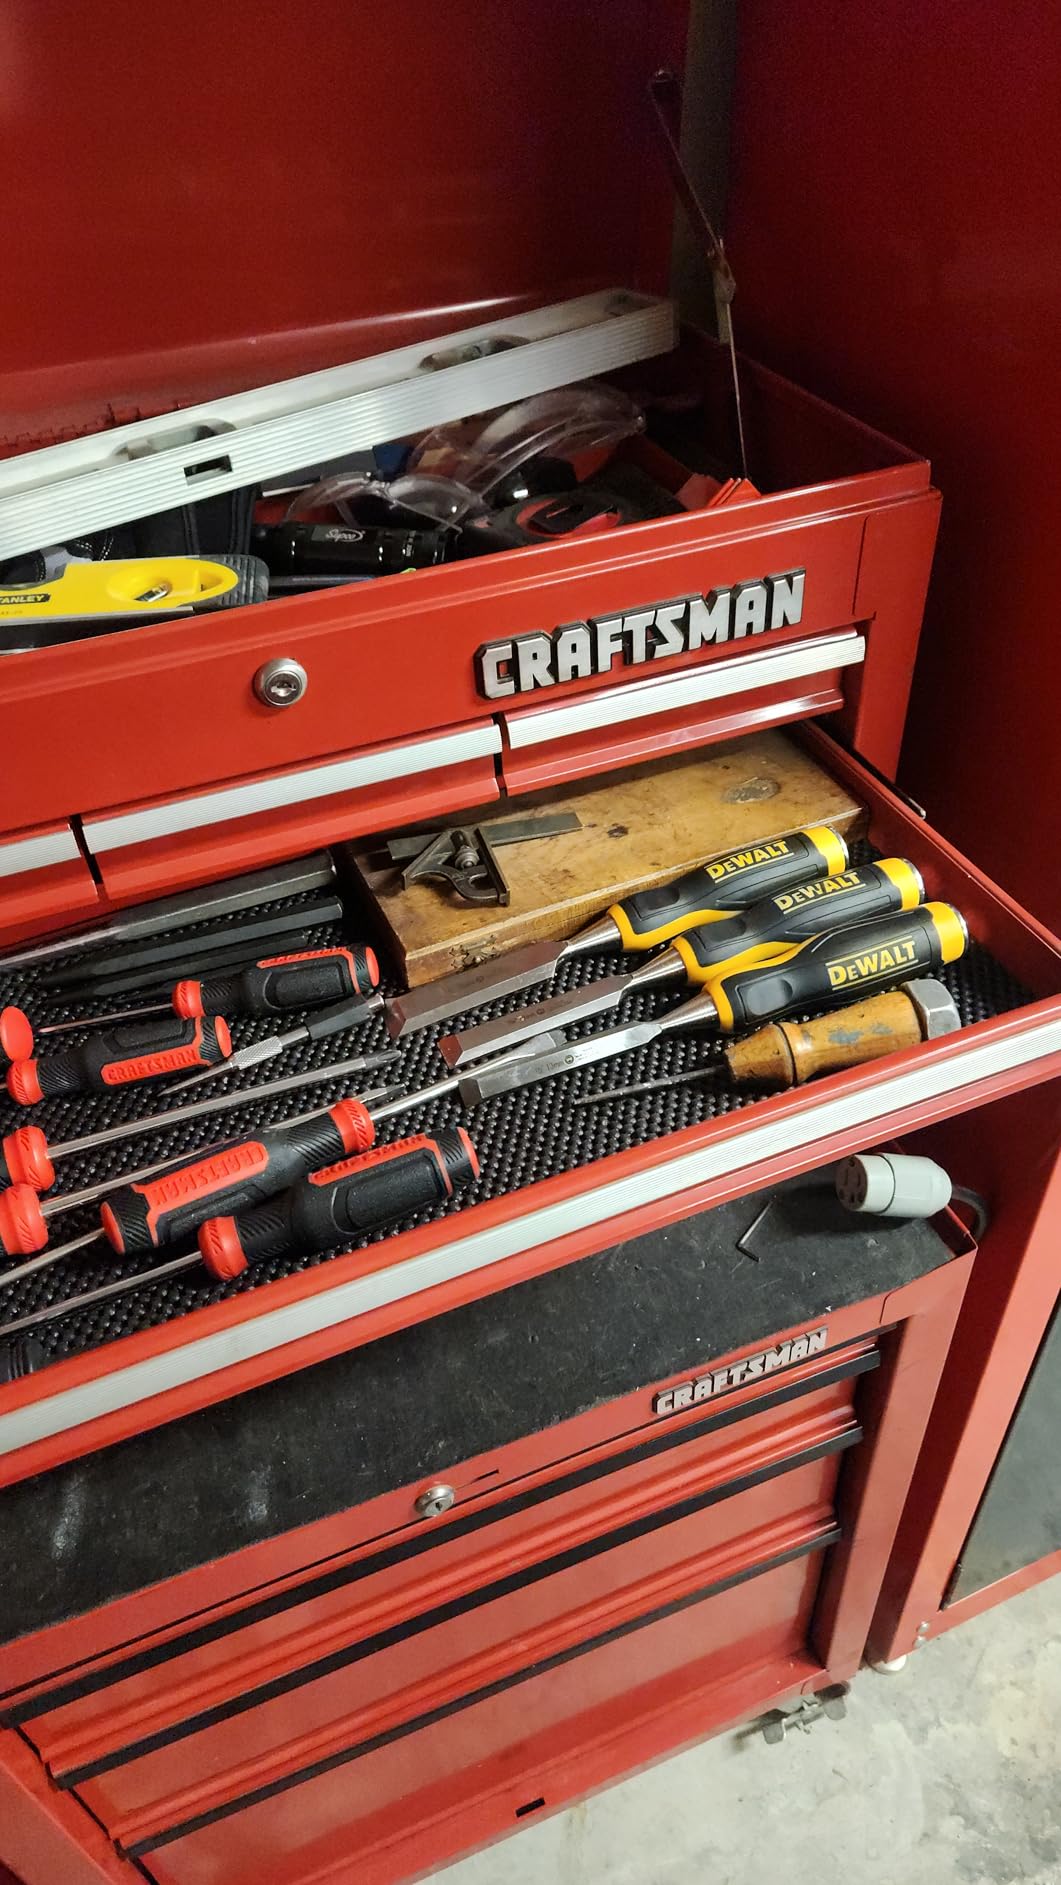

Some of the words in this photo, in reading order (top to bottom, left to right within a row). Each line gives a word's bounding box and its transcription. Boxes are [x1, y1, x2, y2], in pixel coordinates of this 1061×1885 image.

[475, 567, 806, 699] CRAFTSMAN
[107, 1048, 198, 1081] CRAFTSMAN
[653, 1325, 828, 1414] CRAFTSMAN
